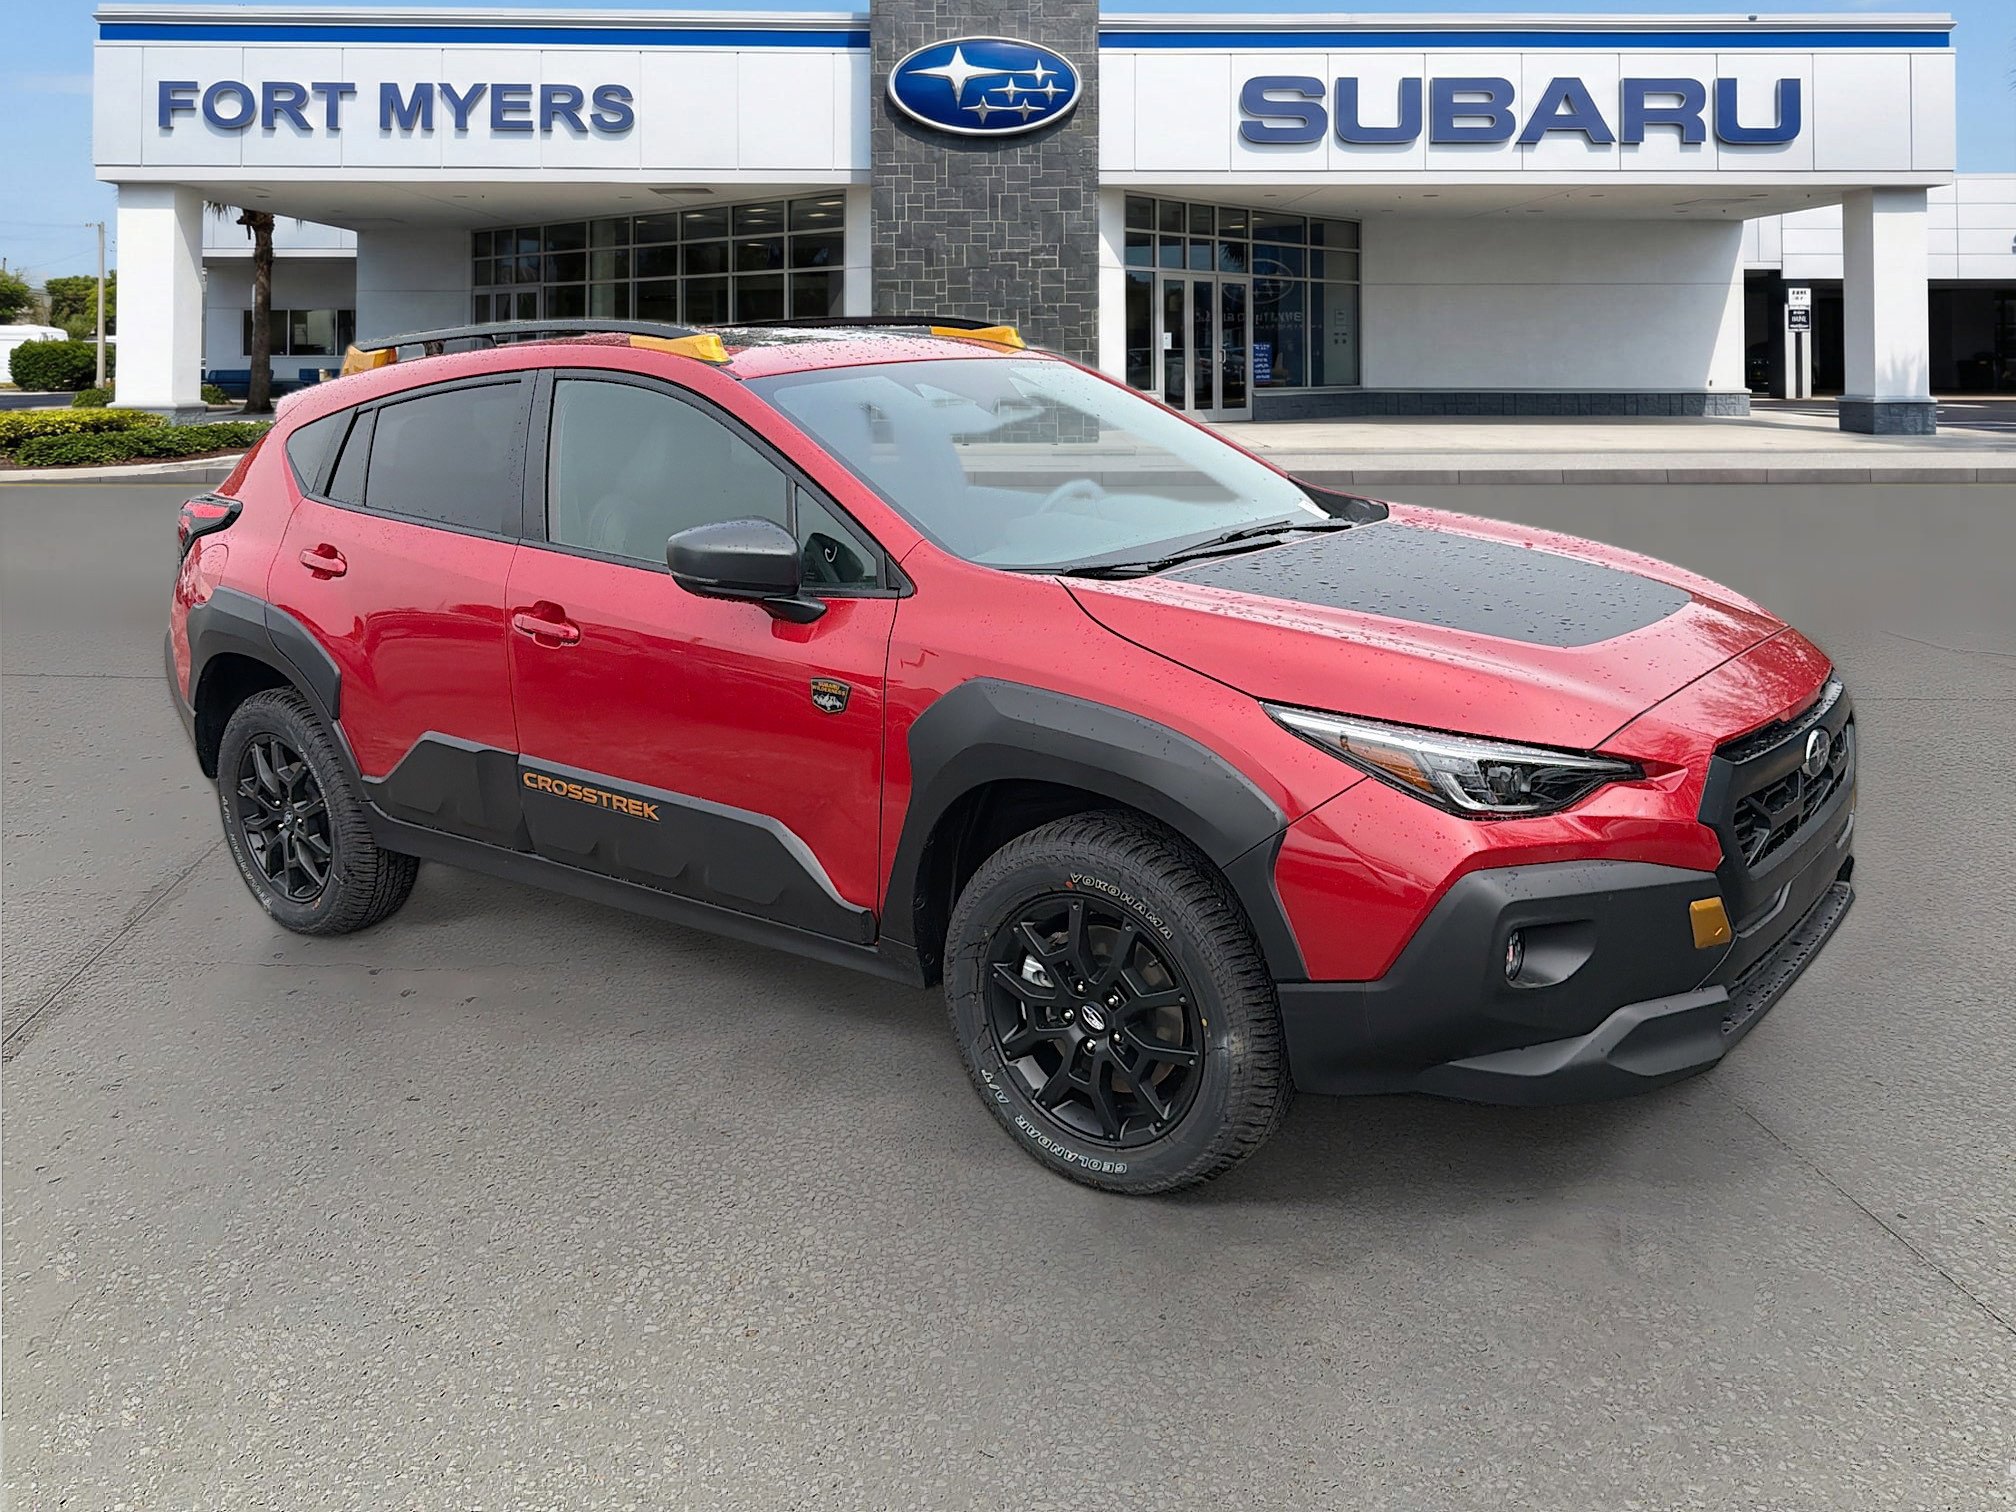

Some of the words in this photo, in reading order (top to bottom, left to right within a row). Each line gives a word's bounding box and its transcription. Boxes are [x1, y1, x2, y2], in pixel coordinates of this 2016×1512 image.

[158, 80, 357, 132] FORT
[379, 82, 635, 133] MYERS
[1239, 75, 1801, 146] SUBARU
[523, 772, 660, 821] CROSSTREK
[1070, 872, 1174, 940] YOKOHAMA
[980, 1069, 1010, 1103] A/T
[1014, 1114, 1128, 1174] GEOLANDAR
